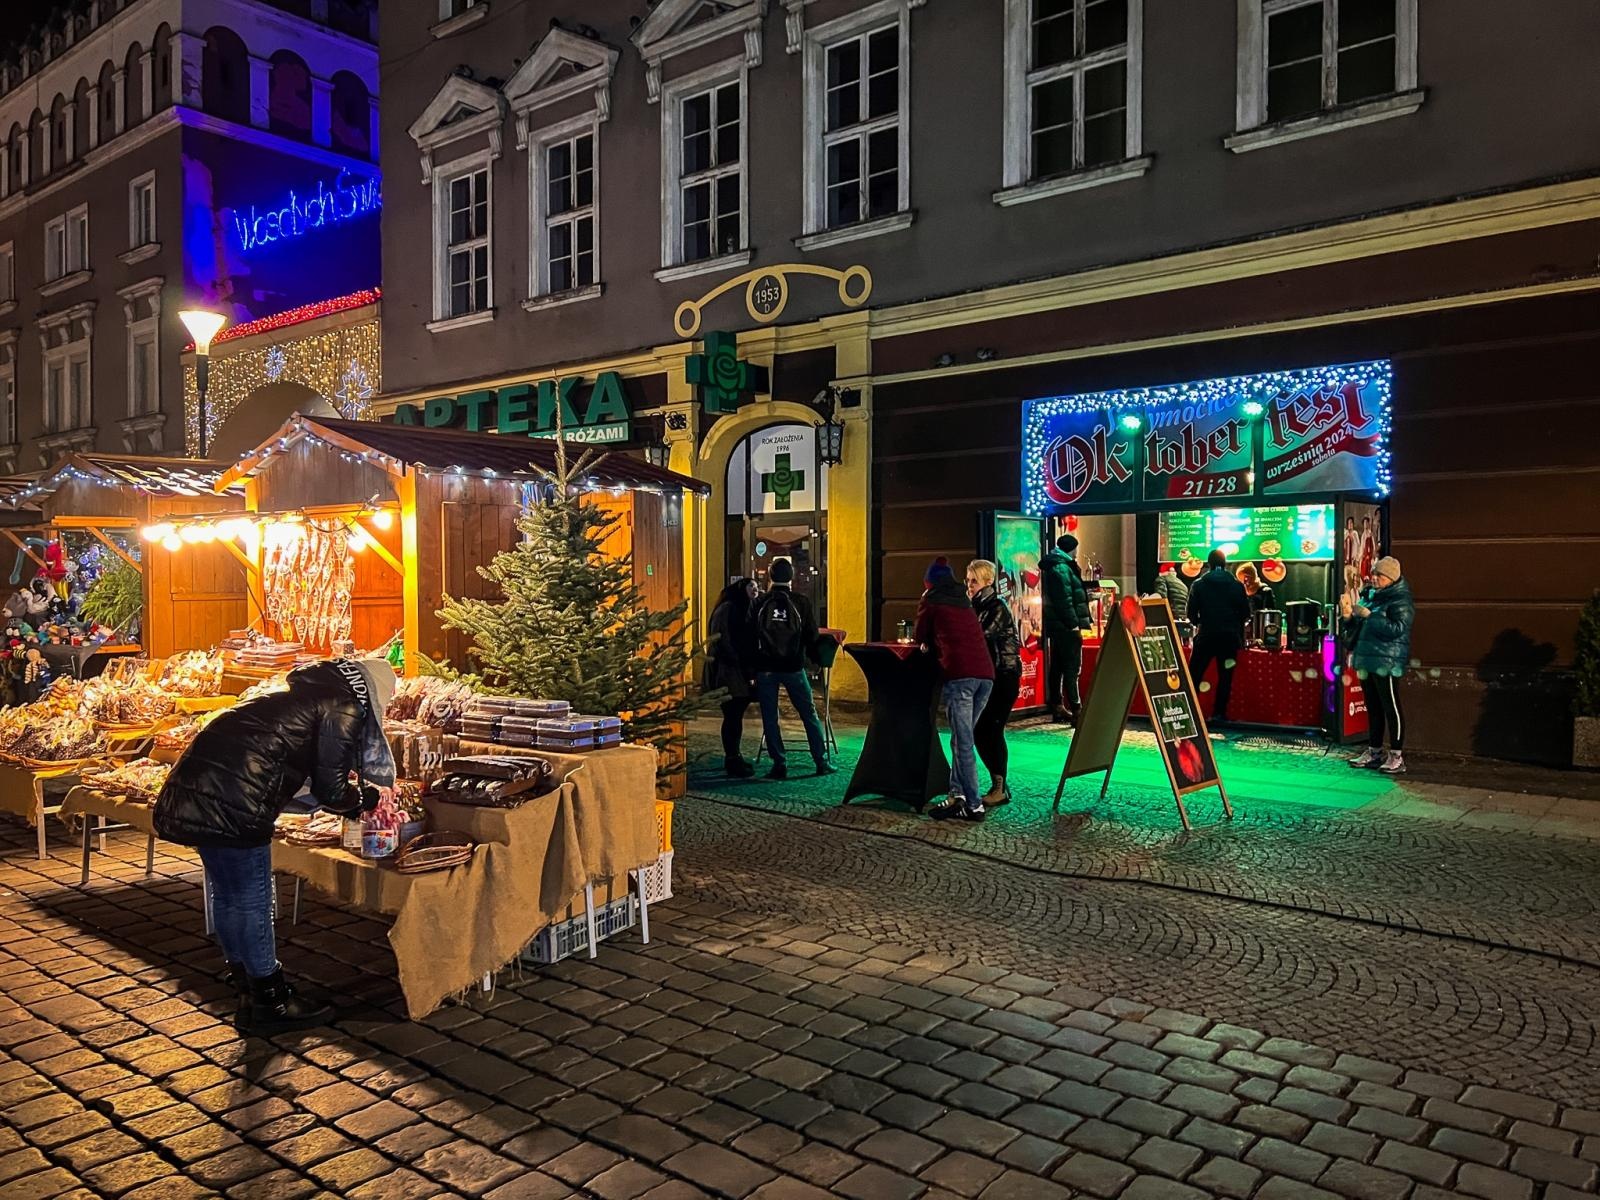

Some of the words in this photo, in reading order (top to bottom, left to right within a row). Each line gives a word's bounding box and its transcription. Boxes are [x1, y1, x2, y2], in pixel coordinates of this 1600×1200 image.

[764, 279, 770, 287] A
[755, 287, 780, 304] 1953
[764, 303, 770, 313] D
[393, 371, 631, 434] APTEKA
[566, 427, 623, 442] RÓŻAMI
[1182, 480, 1203, 496] 21
[1207, 479, 1214, 494] i
[1215, 476, 1237, 494] 28
[1267, 441, 1323, 479] września
[1324, 426, 1352, 450] 2024
[1311, 448, 1336, 466] sobota
